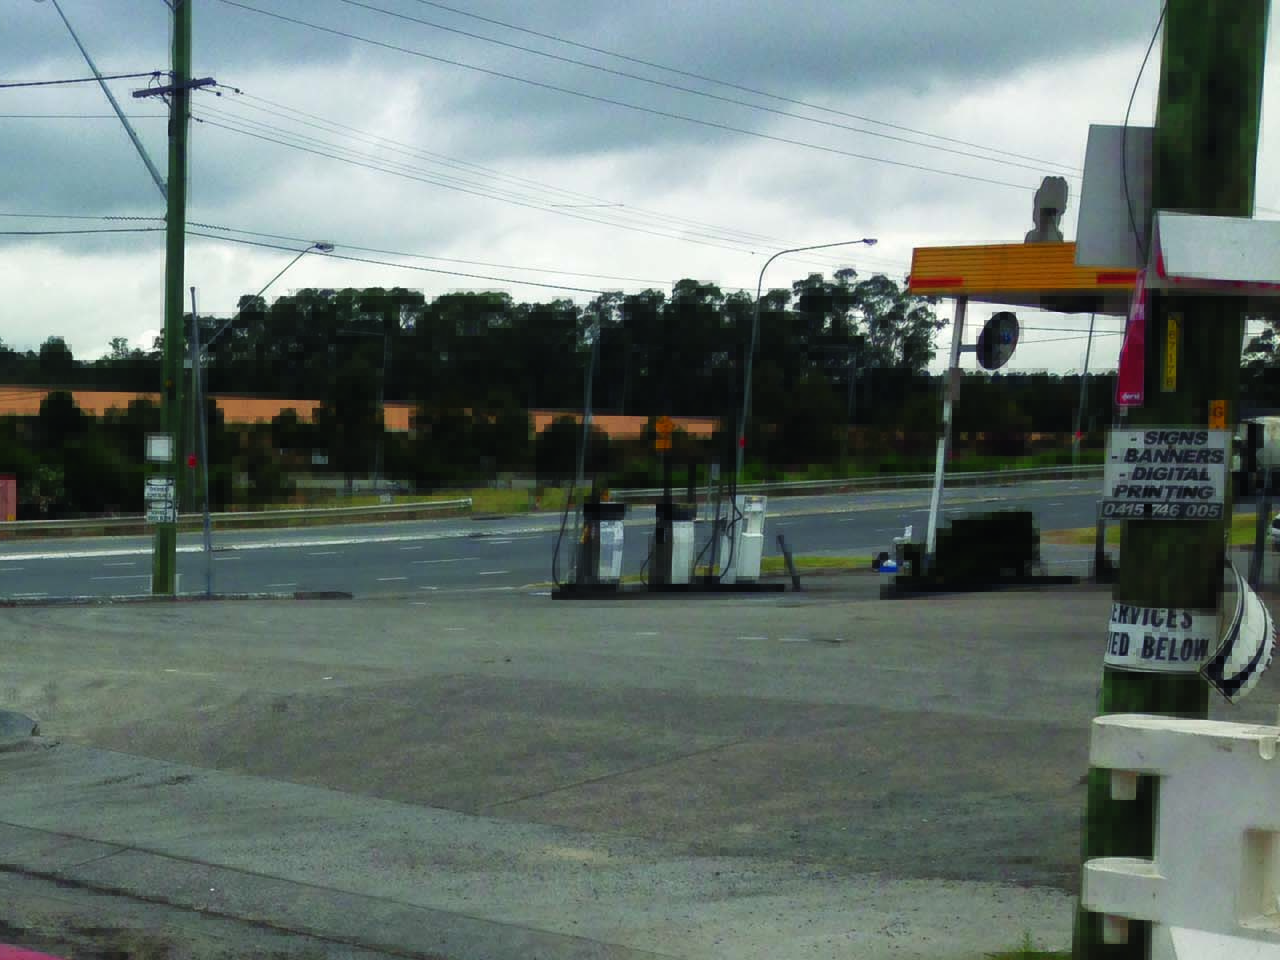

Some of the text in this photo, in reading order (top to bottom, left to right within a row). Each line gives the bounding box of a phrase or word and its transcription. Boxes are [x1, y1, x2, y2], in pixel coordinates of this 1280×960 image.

[1143, 431, 1208, 446] SIGNS
[1123, 448, 1225, 463] BANNERS
[1131, 466, 1211, 481] DIGITAL
[1113, 484, 1216, 499] PRINTING
[1103, 502, 1220, 518] 0415 746 005
[1141, 635, 1210, 662] BELOW
